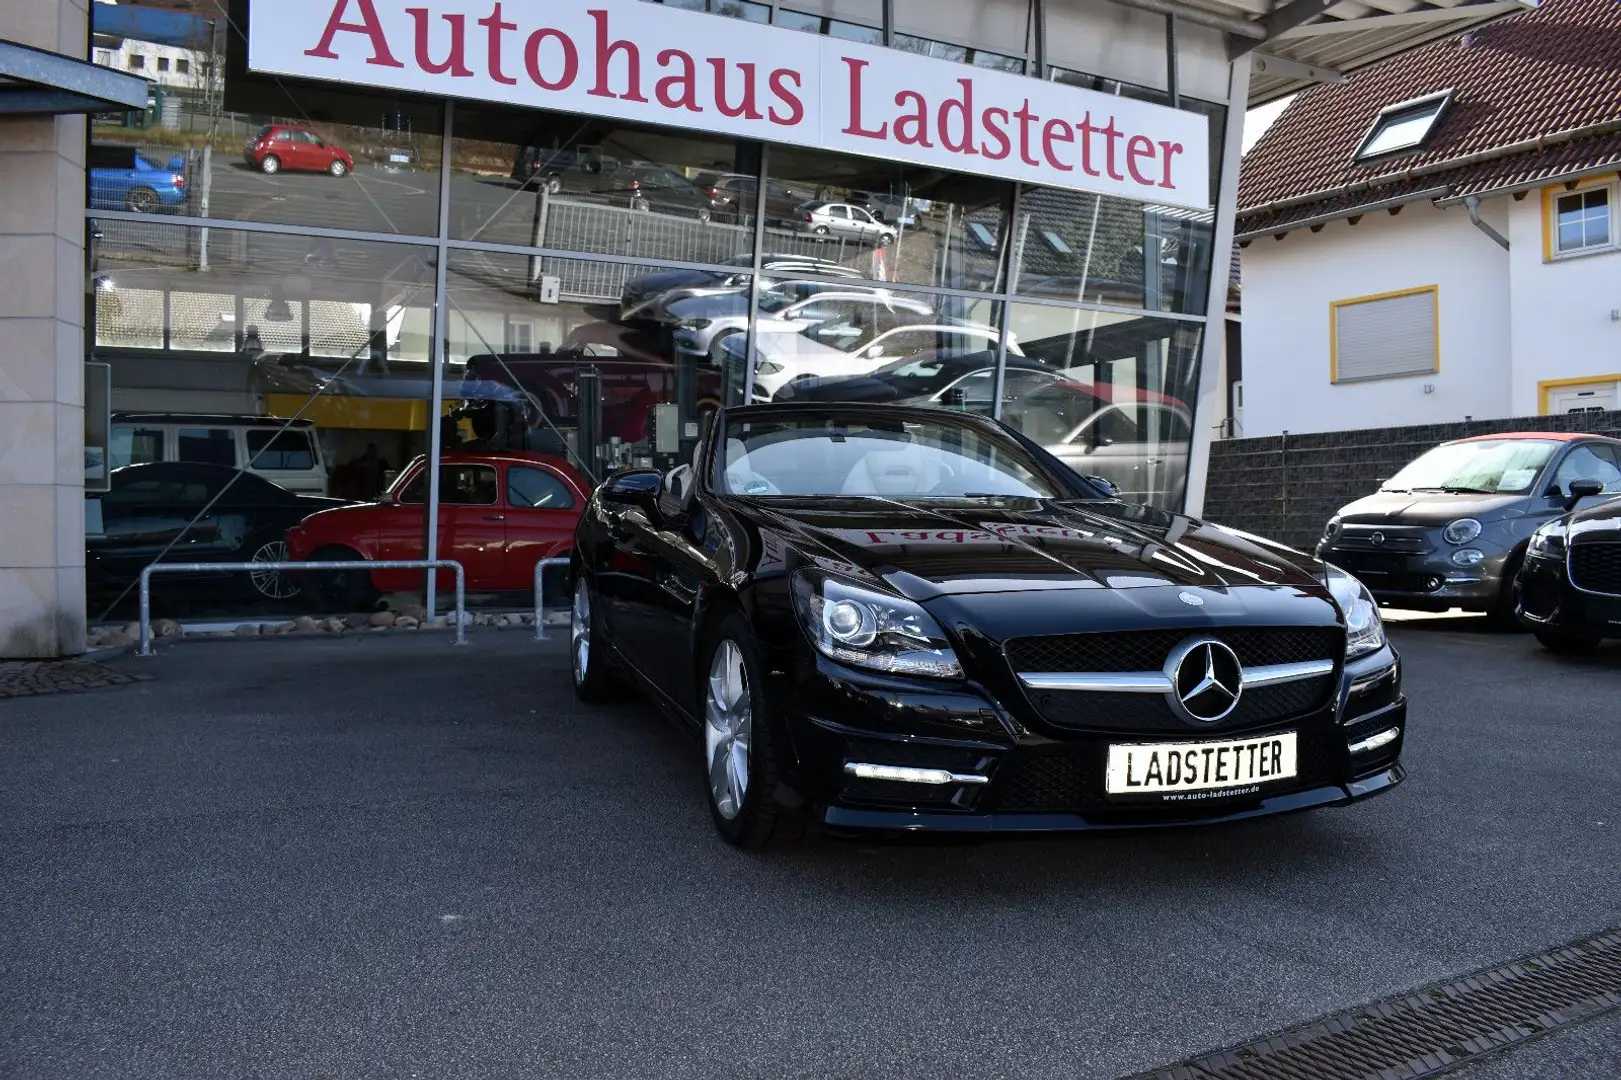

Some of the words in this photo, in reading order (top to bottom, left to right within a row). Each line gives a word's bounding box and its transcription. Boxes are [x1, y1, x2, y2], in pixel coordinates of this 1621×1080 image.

[304, 0, 804, 126] Autohaus
[842, 57, 1183, 190] Ladstetter
[1126, 740, 1282, 787] LADSTETTER
[1162, 785, 1260, 801] www.auto-ladstetter.de
